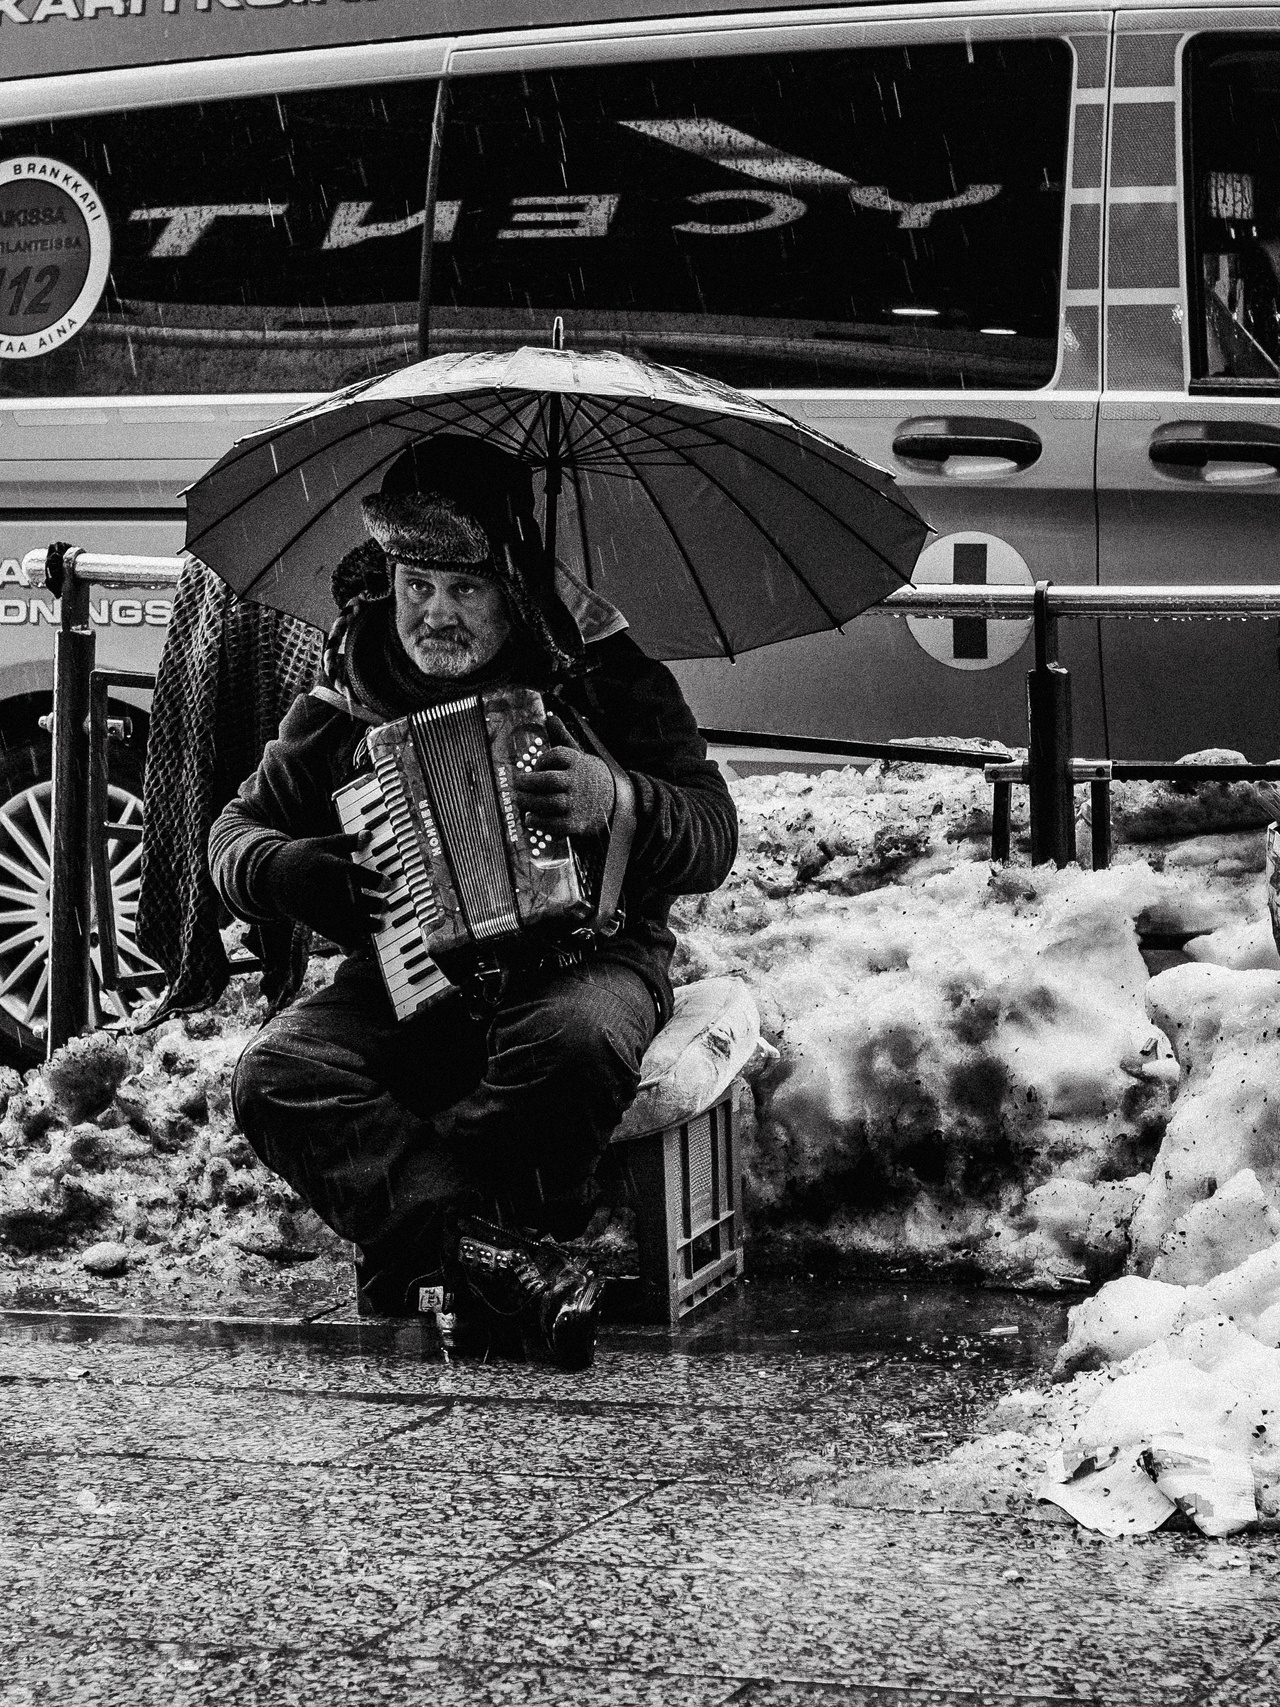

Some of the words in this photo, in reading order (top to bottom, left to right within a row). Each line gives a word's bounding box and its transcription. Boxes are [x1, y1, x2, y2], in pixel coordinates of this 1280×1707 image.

[13, 163, 101, 222] BRANKKARI
[38, 317, 78, 348] AINA
[418, 799, 442, 857] HOHNER
[501, 791, 519, 843] STUDENT
